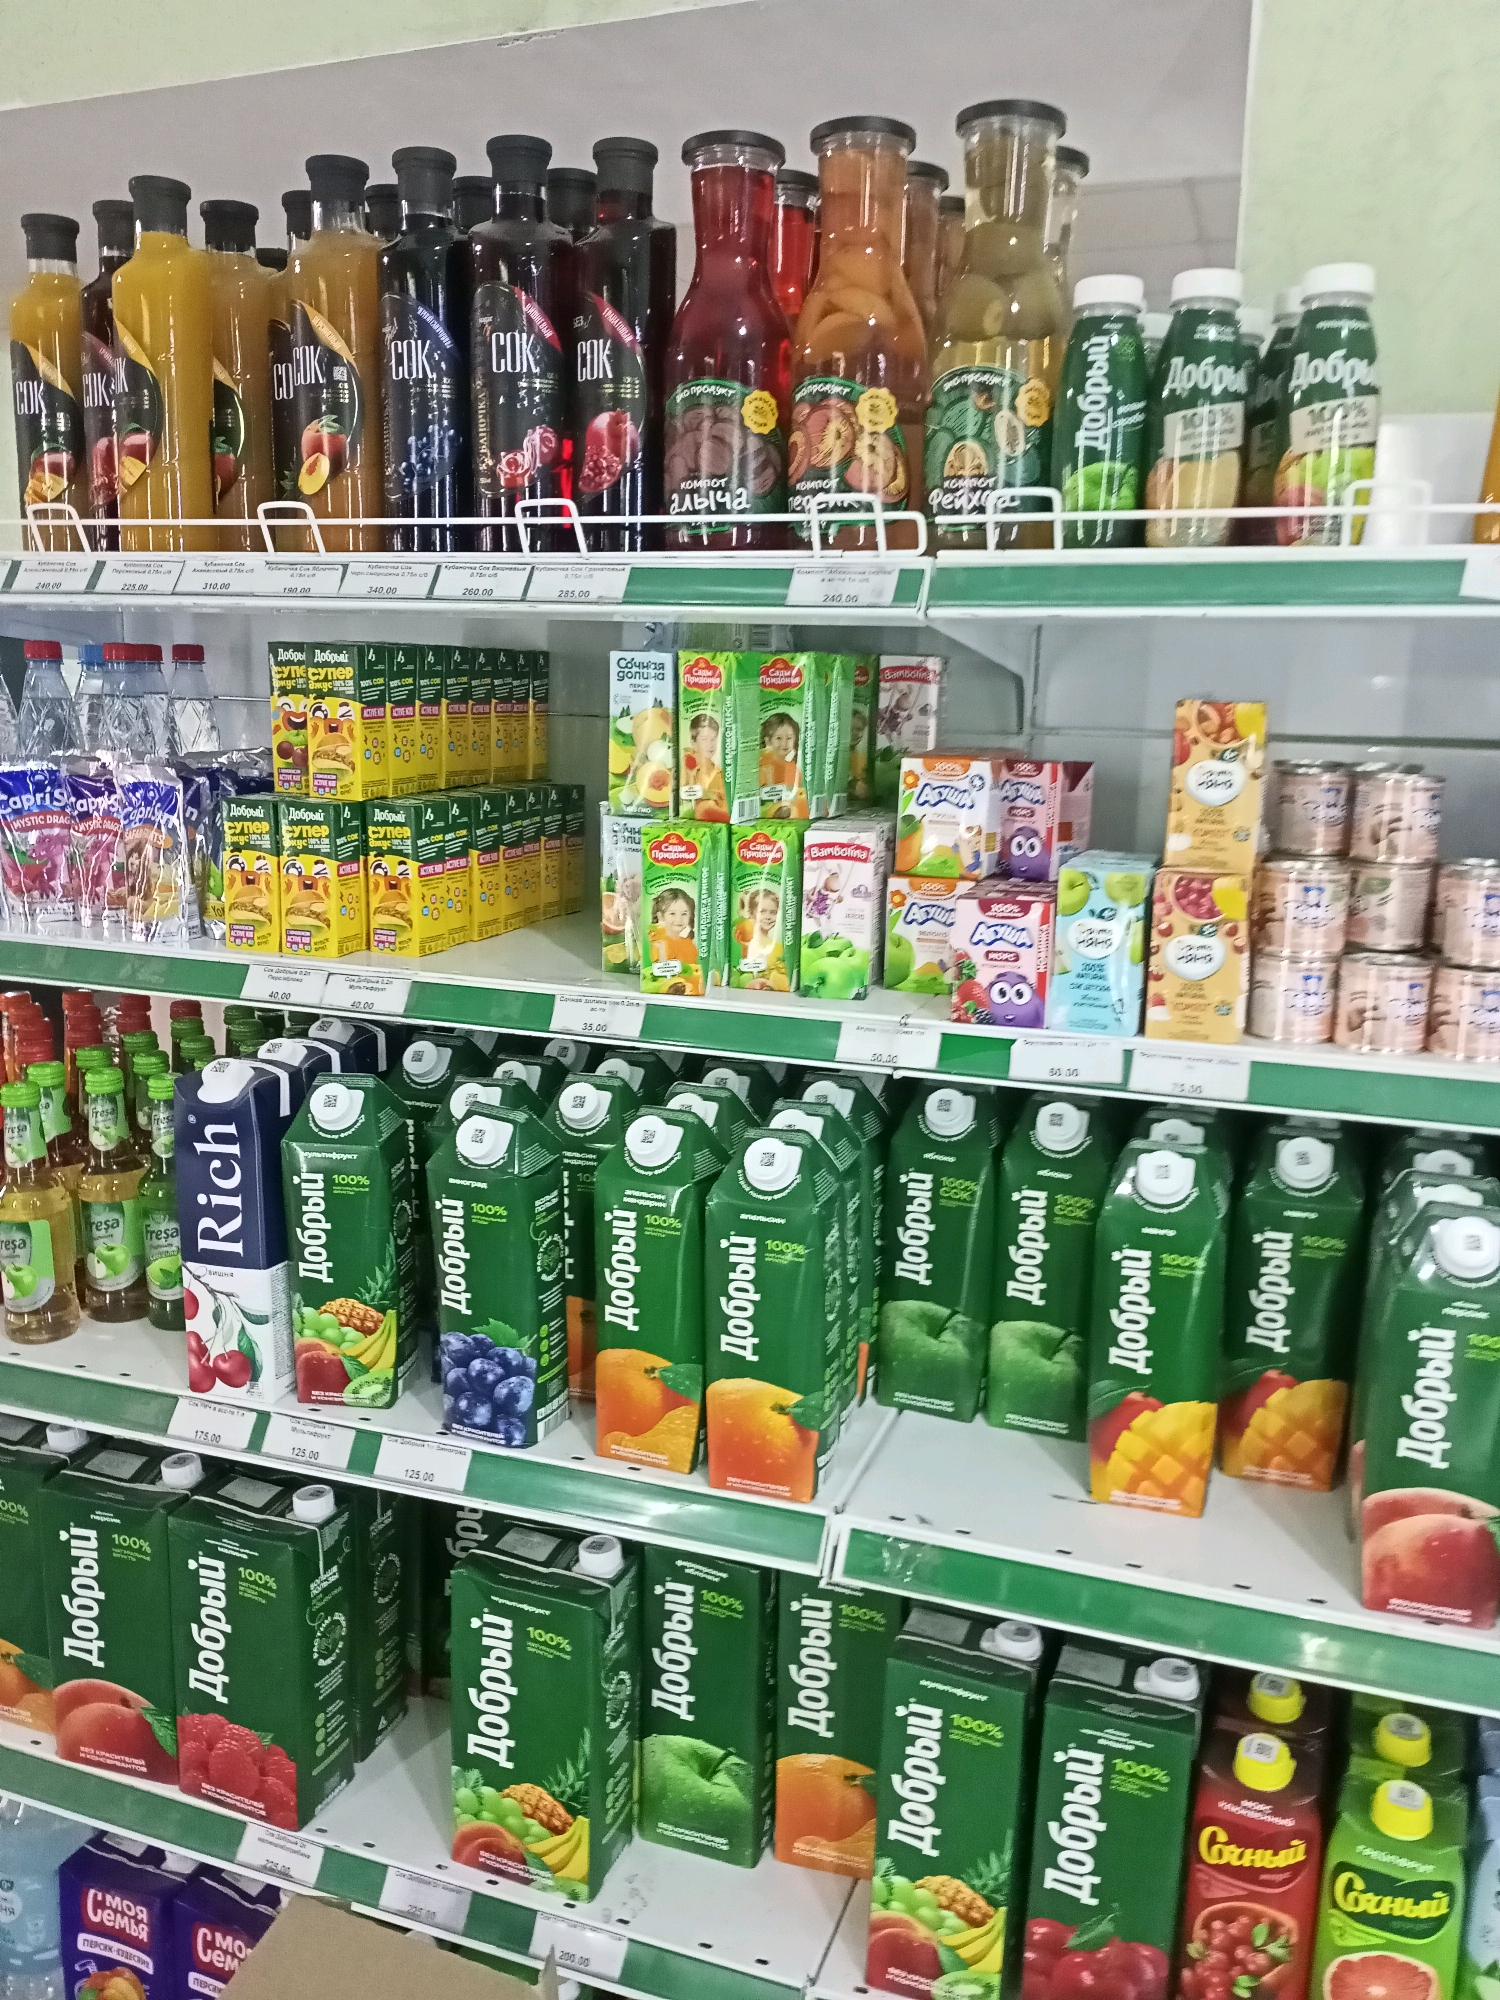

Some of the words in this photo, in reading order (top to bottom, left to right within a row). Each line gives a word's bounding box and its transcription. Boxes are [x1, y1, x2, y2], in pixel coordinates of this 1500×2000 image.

[391, 339, 433, 381] СОК
[491, 332, 539, 374] СОК
[577, 339, 613, 383] СОК
[292, 345, 325, 385] СОК
[16, 381, 46, 416] СОК
[83, 372, 110, 408] СОК
[669, 488, 751, 515] алыча
[313, 648, 349, 665] Добрый
[617, 657, 665, 671] Сочная
[307, 666, 354, 682] супер
[617, 669, 665, 682] долина
[684, 674, 722, 685] Придонья
[691, 667, 713, 678] Сады
[759, 674, 800, 686] Придонья
[769, 668, 791, 679] Сады
[229, 802, 265, 819] Добрый
[288, 807, 325, 822] Добрый
[373, 808, 406, 823] Добрый
[13, 815, 46, 832] MYSTIC
[651, 849, 697, 861] Придонья
[661, 842, 687, 854] Сады
[740, 849, 784, 860] Придонья
[749, 842, 774, 853] Сады
[197, 1121, 244, 1258] Rich
[332, 1174, 370, 1186] 100%
[448, 1178, 488, 1189] виноград
[940, 1176, 979, 1193] 100%
[939, 1186, 973, 1200] СОК
[1054, 1193, 1095, 1210] 100%
[471, 1203, 508, 1216] 100%
[643, 1213, 682, 1229] 100%
[1053, 1204, 1090, 1219] СОК
[293, 1172, 333, 1283] Добрый
[894, 1171, 936, 1286] Добрый
[764, 1239, 806, 1256] 100%
[1006, 1188, 1050, 1306] Добрый
[1301, 1235, 1348, 1251] 100%
[435, 1196, 472, 1316] Добрый
[1160, 1253, 1207, 1269] 100%
[603, 1210, 641, 1332] Добрый
[719, 1236, 761, 1362] Добрый
[1246, 1231, 1296, 1354] Добрый
[1108, 1247, 1156, 1375] Добрый
[1396, 1327, 1457, 1470] Добрый
[90, 1514, 122, 1524] персик
[111, 1533, 151, 1554] 100%
[238, 1566, 277, 1590] 100%
[60, 1523, 106, 1668] Добрый
[700, 1589, 745, 1612] 100%
[838, 1603, 887, 1624] 100%
[188, 1552, 232, 1704] Добрый
[526, 1625, 572, 1652] 100%
[651, 1578, 698, 1721] Добрый
[787, 1594, 838, 1738] Добрый
[467, 1608, 518, 1769] Добрый
[949, 1713, 1004, 1741] 100%
[886, 1699, 947, 1857] Добрый
[1111, 1758, 1171, 1785] 100%
[1043, 1744, 1107, 1906] Добрый
[1198, 1825, 1307, 1869] Сочный
[1333, 1871, 1450, 1919] Сочный
